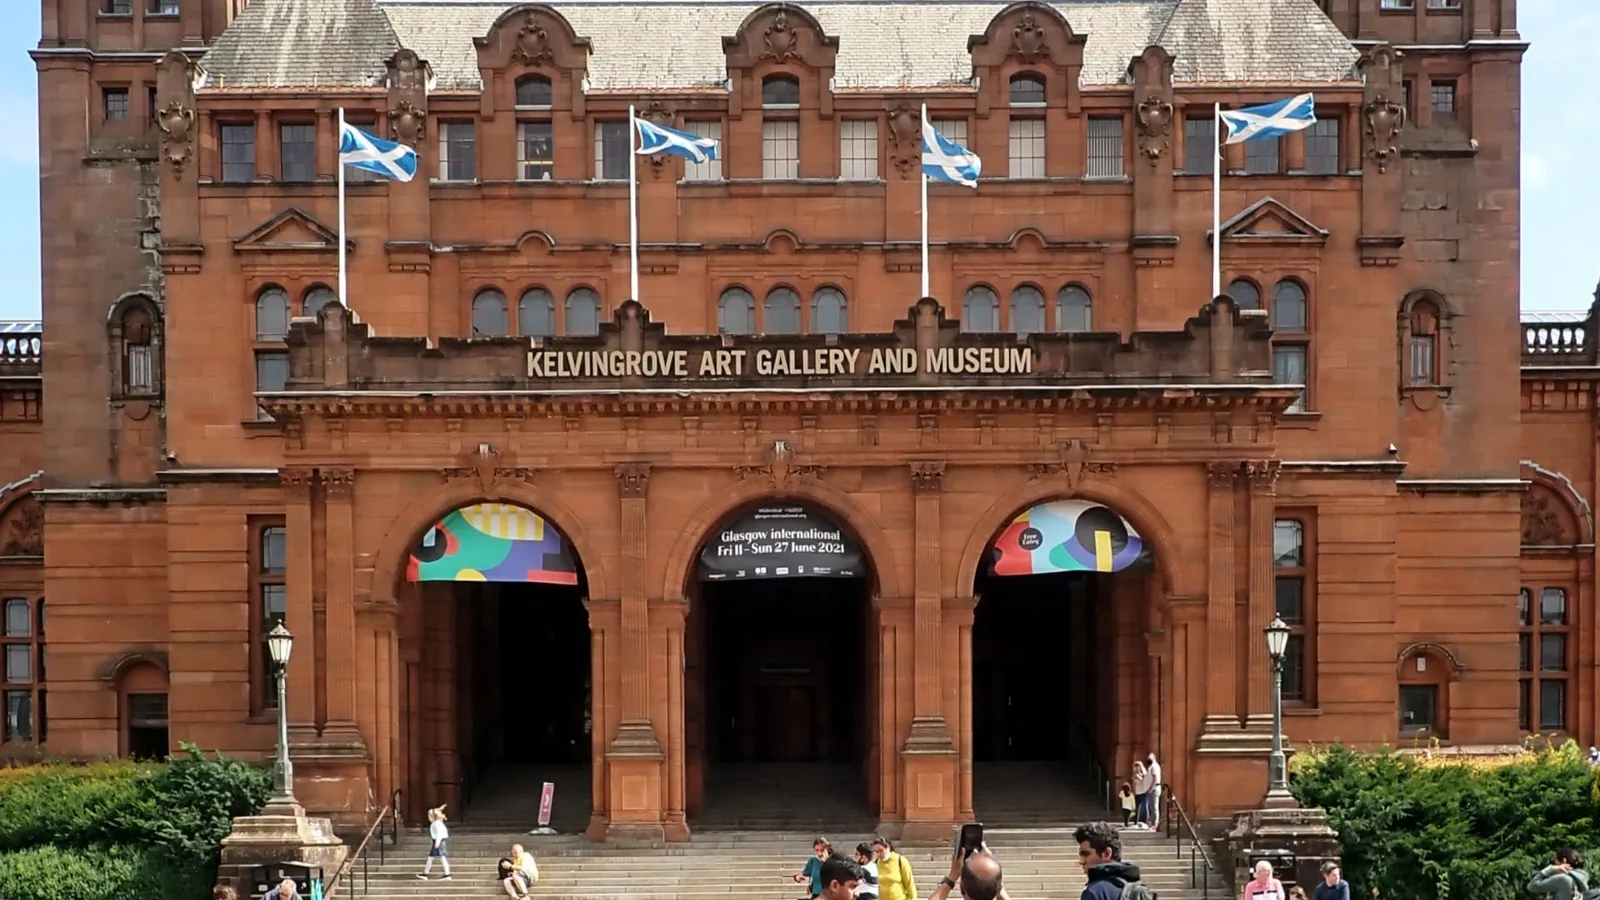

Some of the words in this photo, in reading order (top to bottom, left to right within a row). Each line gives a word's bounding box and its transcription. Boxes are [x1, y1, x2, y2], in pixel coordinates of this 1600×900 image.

[527, 350, 688, 377] KELVINGROVE
[699, 350, 746, 375] ART
[756, 348, 860, 375] GALLERY
[868, 348, 918, 374] AND
[926, 347, 1032, 373] MUSEUM
[721, 531, 768, 544] Glasgow
[770, 528, 840, 540] international
[717, 544, 732, 556] Fri
[774, 541, 789, 552] 27
[790, 542, 816, 553] June
[817, 542, 844, 553] 2021
